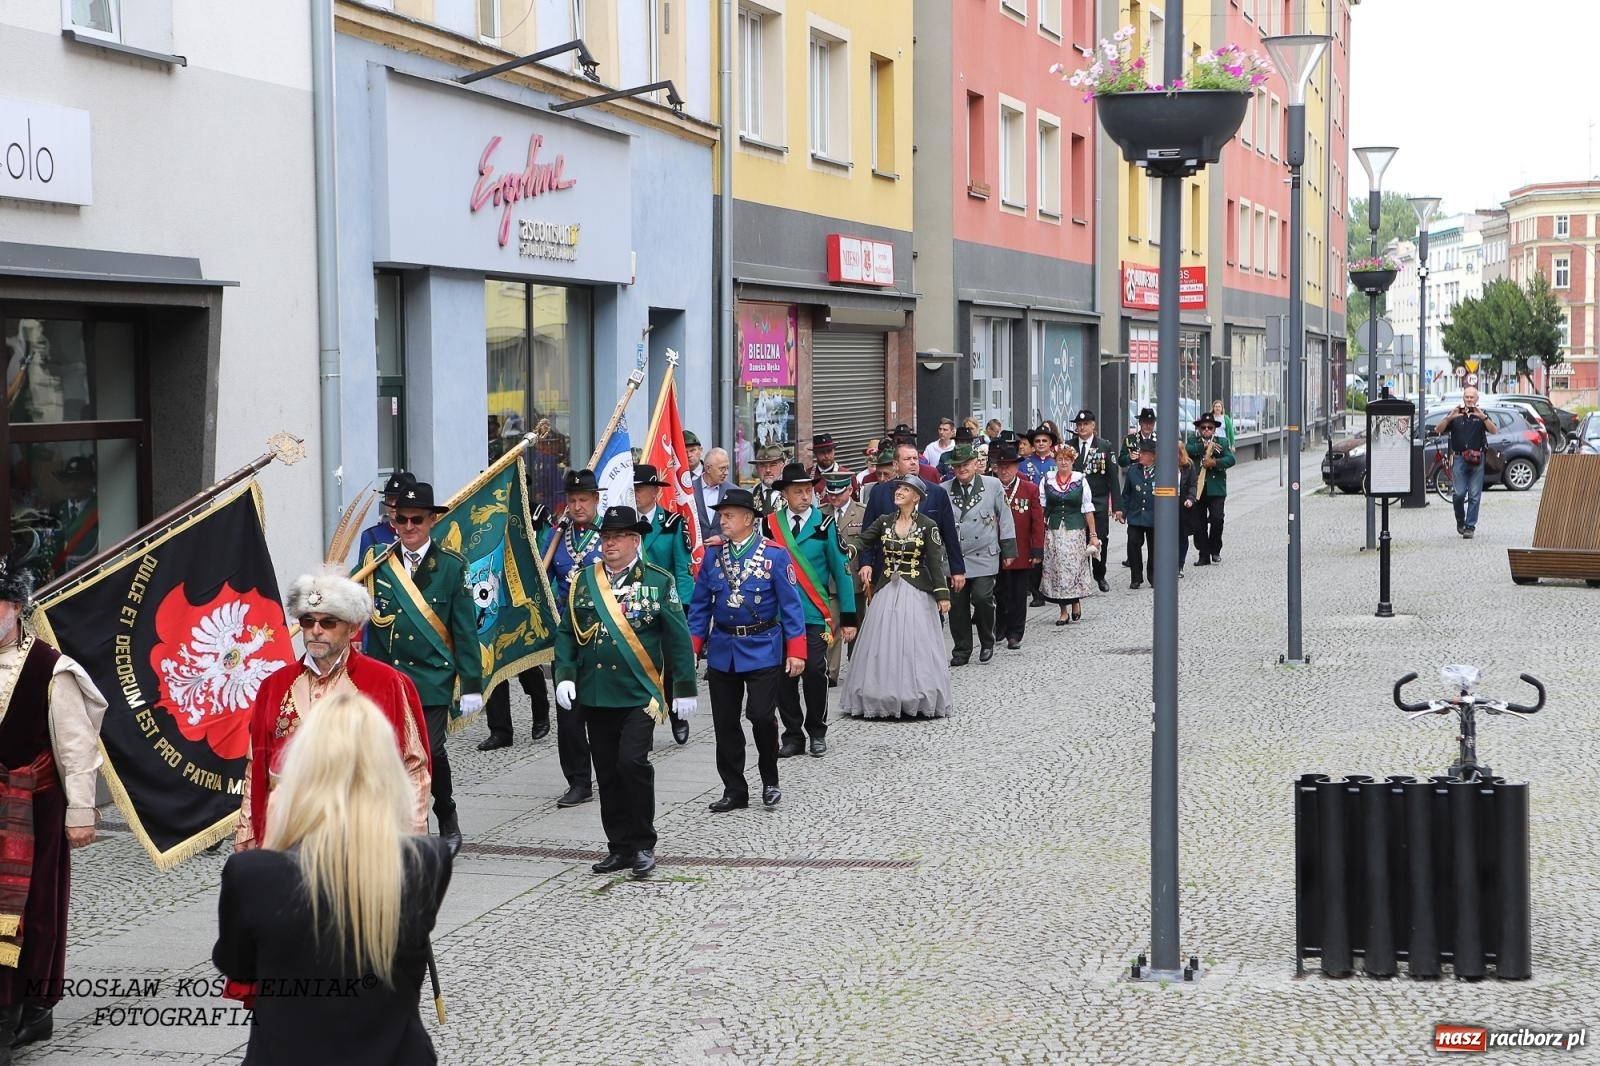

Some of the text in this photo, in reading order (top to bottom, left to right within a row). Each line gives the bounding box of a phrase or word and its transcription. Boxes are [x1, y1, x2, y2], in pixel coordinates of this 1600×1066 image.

[0, 117, 54, 184] olo
[748, 343, 781, 360] BIELIZNA
[127, 554, 159, 604] DULCE
[119, 605, 138, 628] ET
[115, 634, 146, 709] DECORUM
[135, 708, 160, 739] EST
[153, 736, 183, 768] PRO
[182, 761, 222, 791] PATRIA
